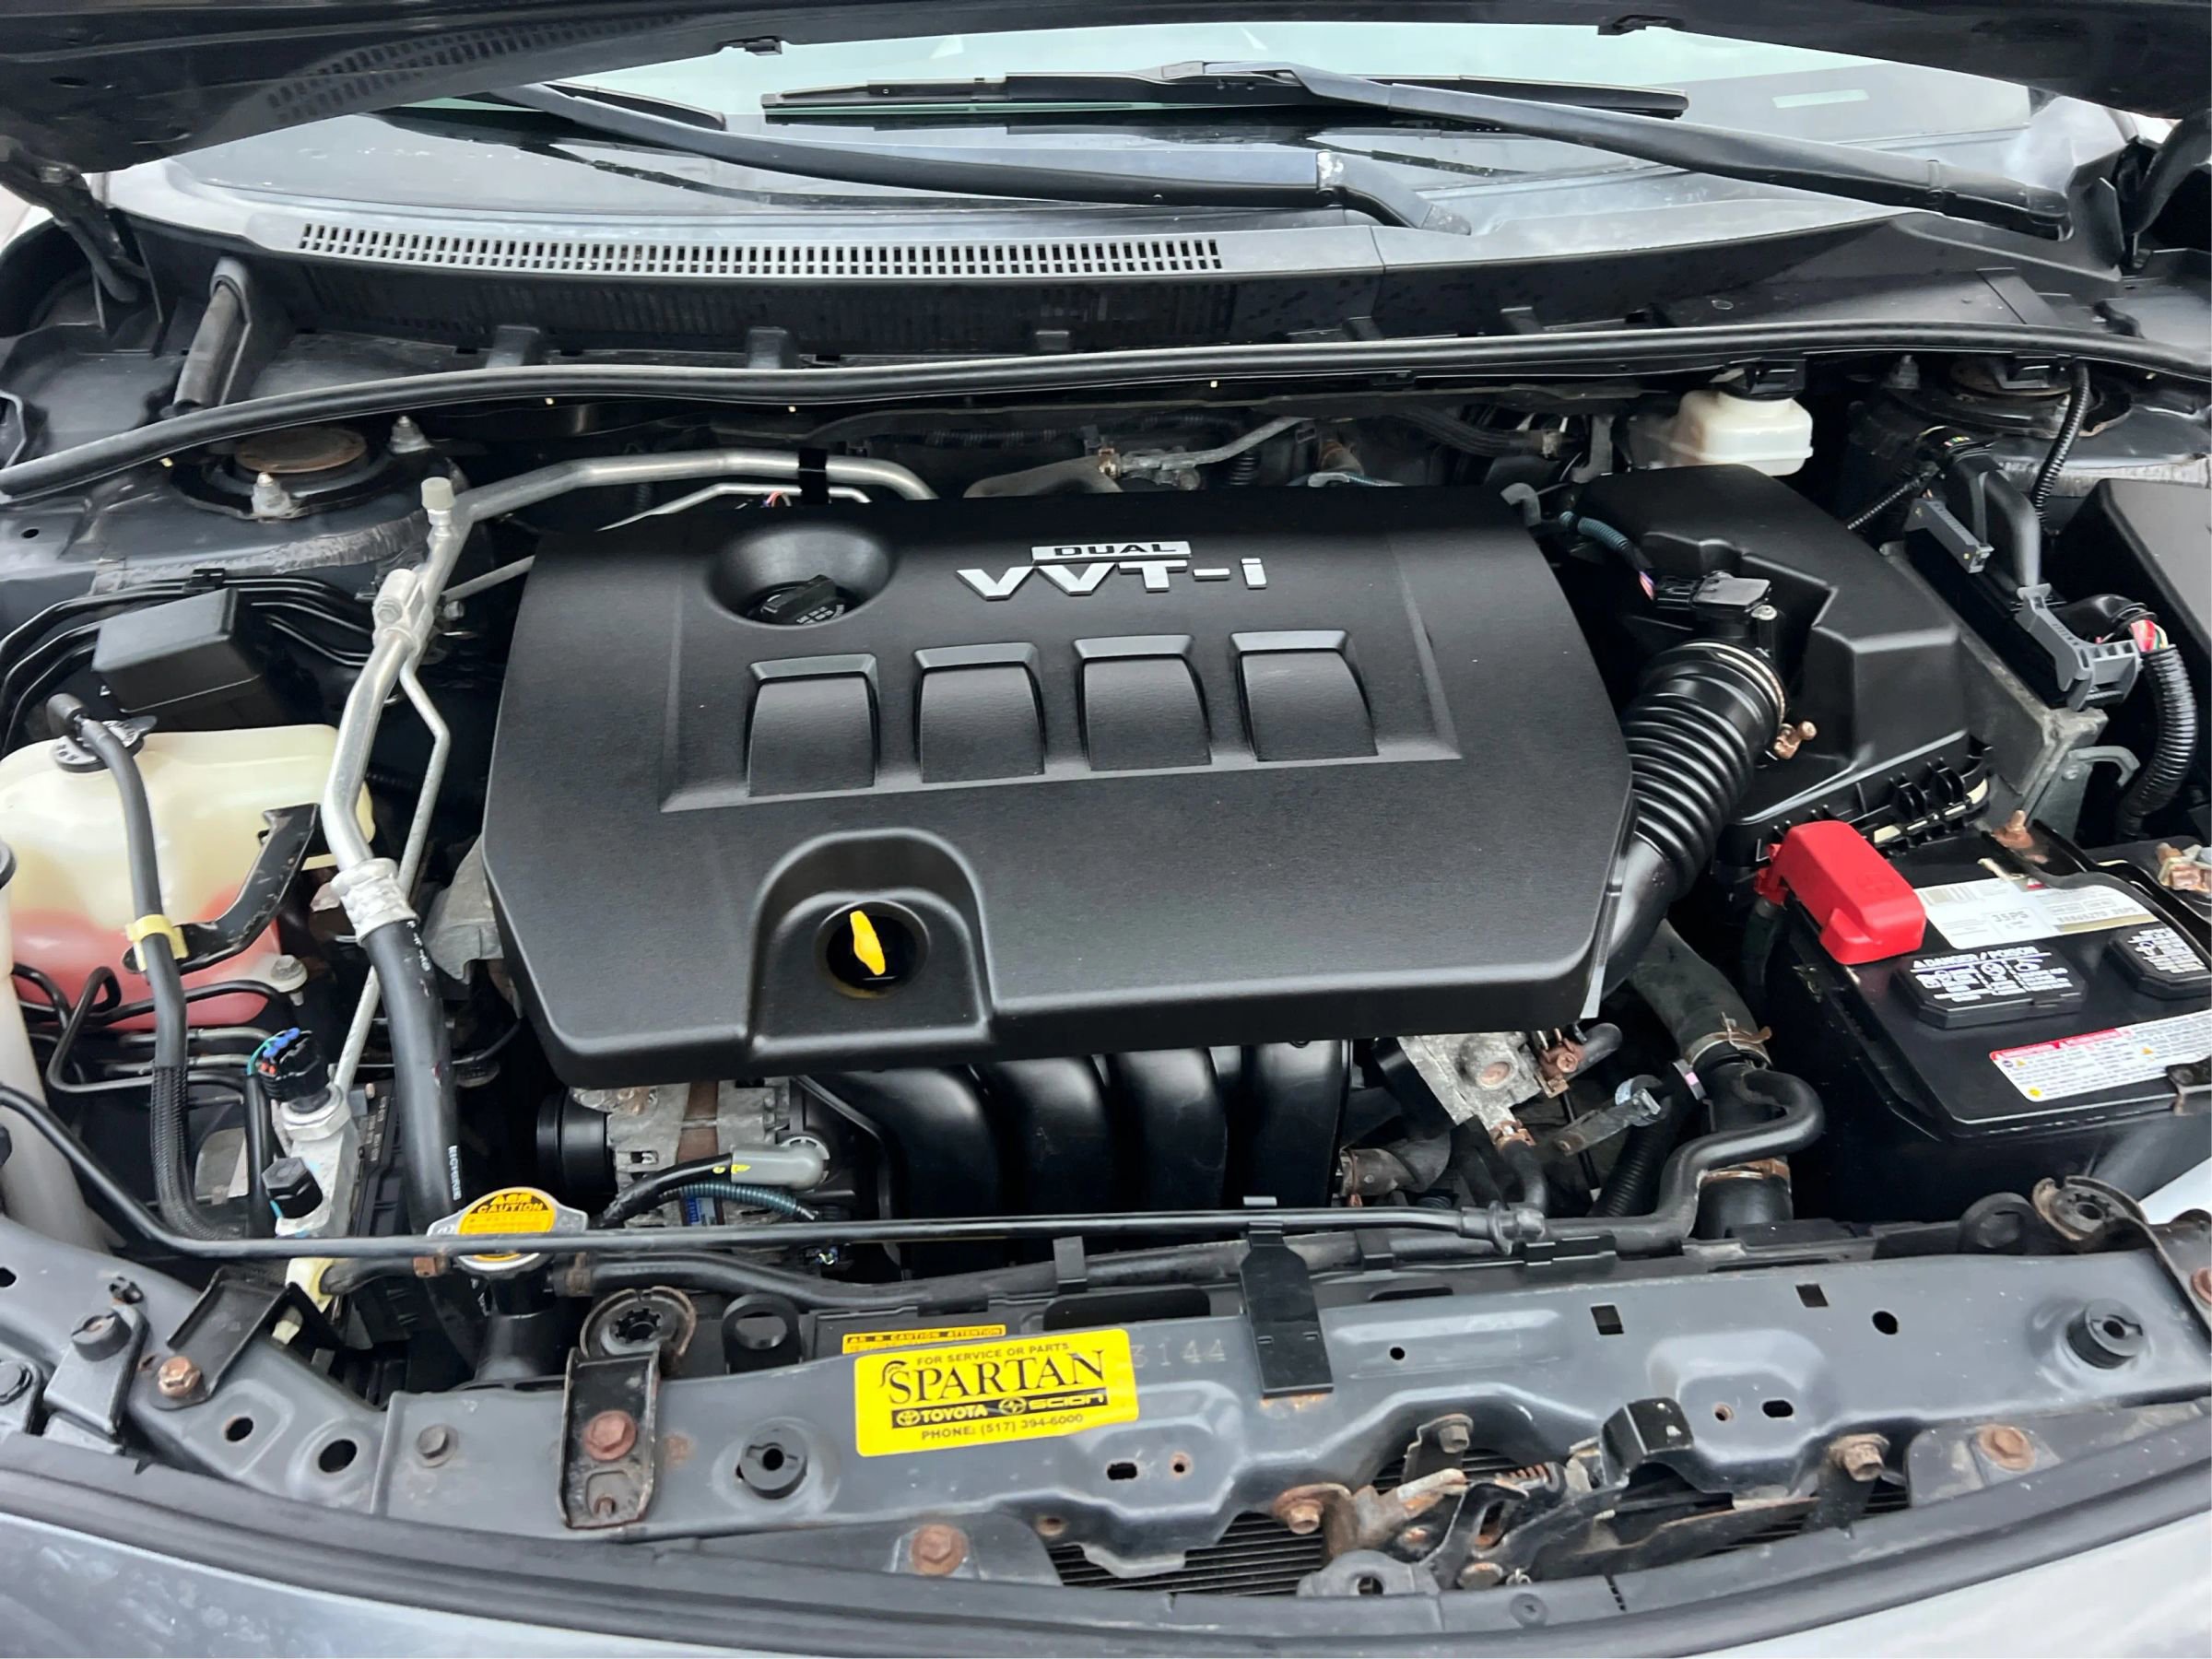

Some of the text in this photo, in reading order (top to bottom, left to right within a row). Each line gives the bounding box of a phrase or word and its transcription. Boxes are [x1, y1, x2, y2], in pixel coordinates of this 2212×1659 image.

[1053, 542, 1177, 557] DUAL
[956, 558, 1267, 600] VVT-i
[477, 1202, 544, 1214] CAUTION
[917, 1341, 1071, 1366] FOR SERVICE OR PARTS
[888, 1348, 1105, 1405] SPARTAN
[923, 1404, 989, 1423] TOYOTA
[921, 1413, 1084, 1441] PHONE: (517) 394-6000
